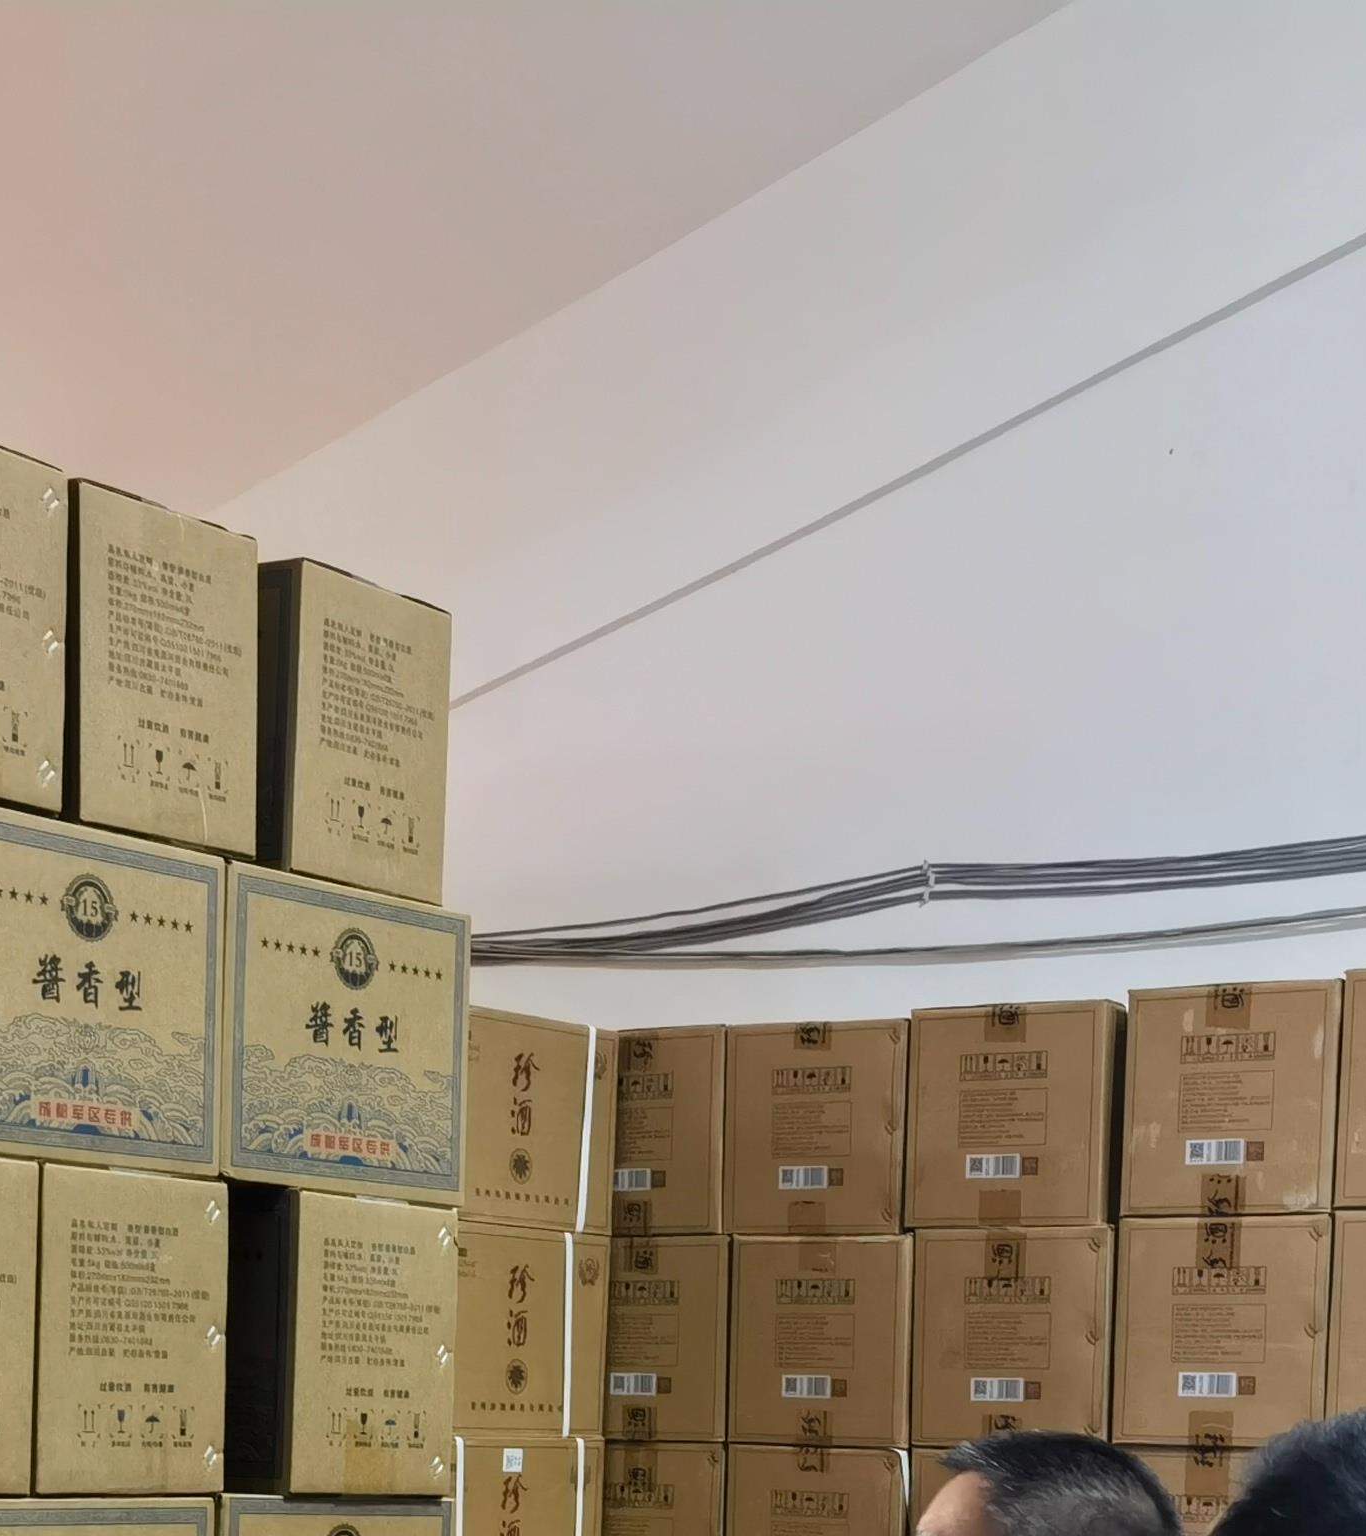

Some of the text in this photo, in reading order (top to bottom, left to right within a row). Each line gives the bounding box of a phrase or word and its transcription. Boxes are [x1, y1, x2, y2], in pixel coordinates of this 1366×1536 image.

[81, 897, 98, 918] 15
[348, 949, 362, 967] 15
[31, 949, 143, 1016] 醬香型
[304, 997, 400, 1057] 醬香型
[38, 1101, 133, 1128] 成都军区专供
[510, 1052, 540, 1136] 珍酒
[310, 1133, 390, 1157] 成都军区专供
[507, 1263, 535, 1348] 珍酒
